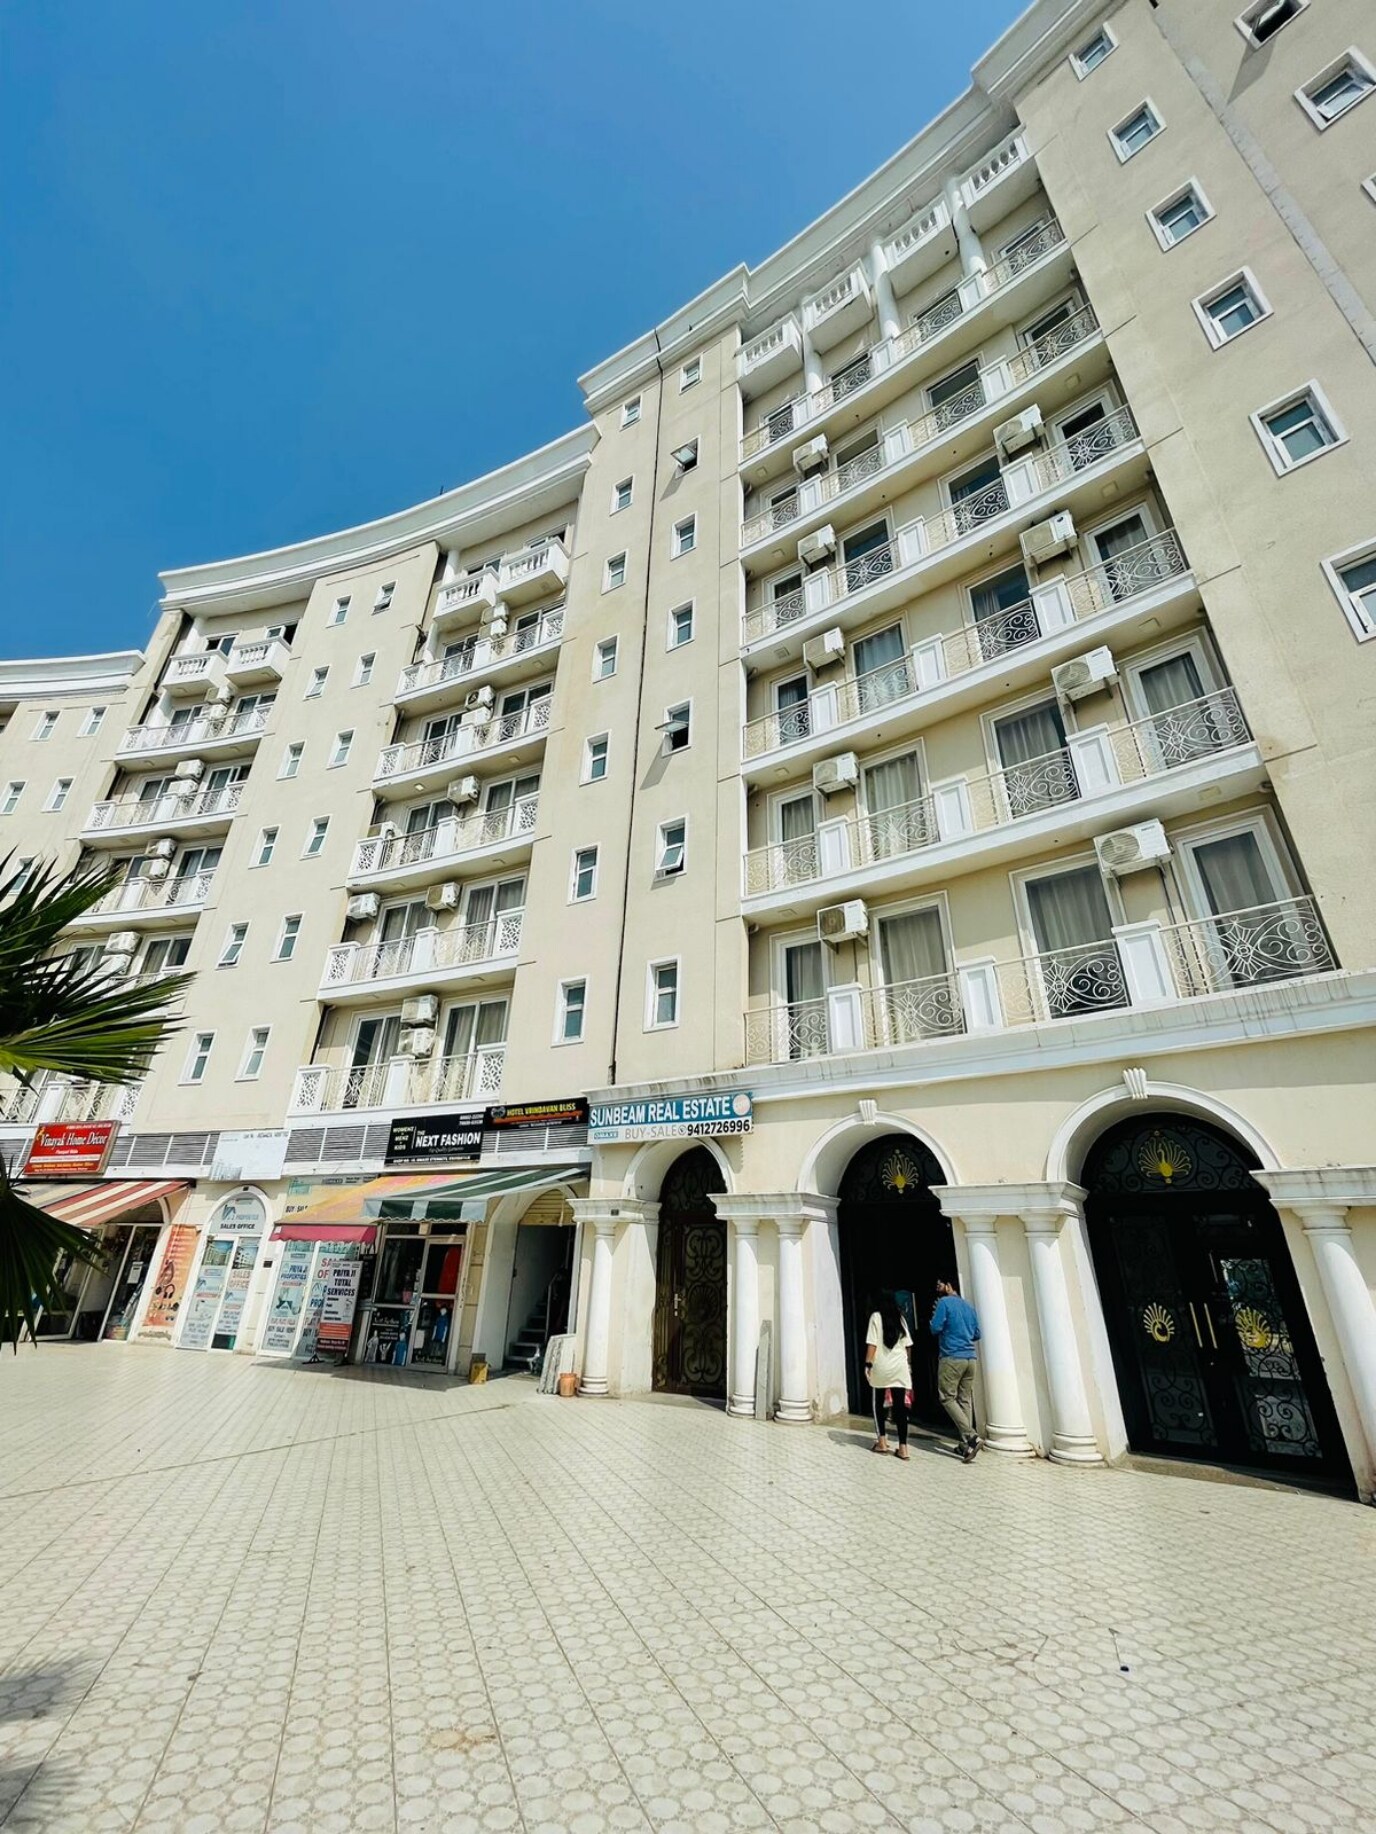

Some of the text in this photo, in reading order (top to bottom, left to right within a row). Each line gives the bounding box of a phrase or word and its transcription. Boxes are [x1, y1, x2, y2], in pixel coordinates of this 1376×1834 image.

[506, 1107, 524, 1116] HOTEL
[559, 1102, 576, 1112] BLISS
[590, 1104, 647, 1127] SUNBEAM
[647, 1102, 680, 1121] REAL
[682, 1096, 731, 1118] ESTATE
[625, 1119, 751, 1140] BUY-SALE 9412726996
[66, 1132, 87, 1146] Home
[415, 1132, 481, 1148] NEXT FASHION
[333, 1269, 351, 1277] PRIYA
[334, 1278, 352, 1287] TOTAL
[327, 1288, 355, 1297] SERVICES
